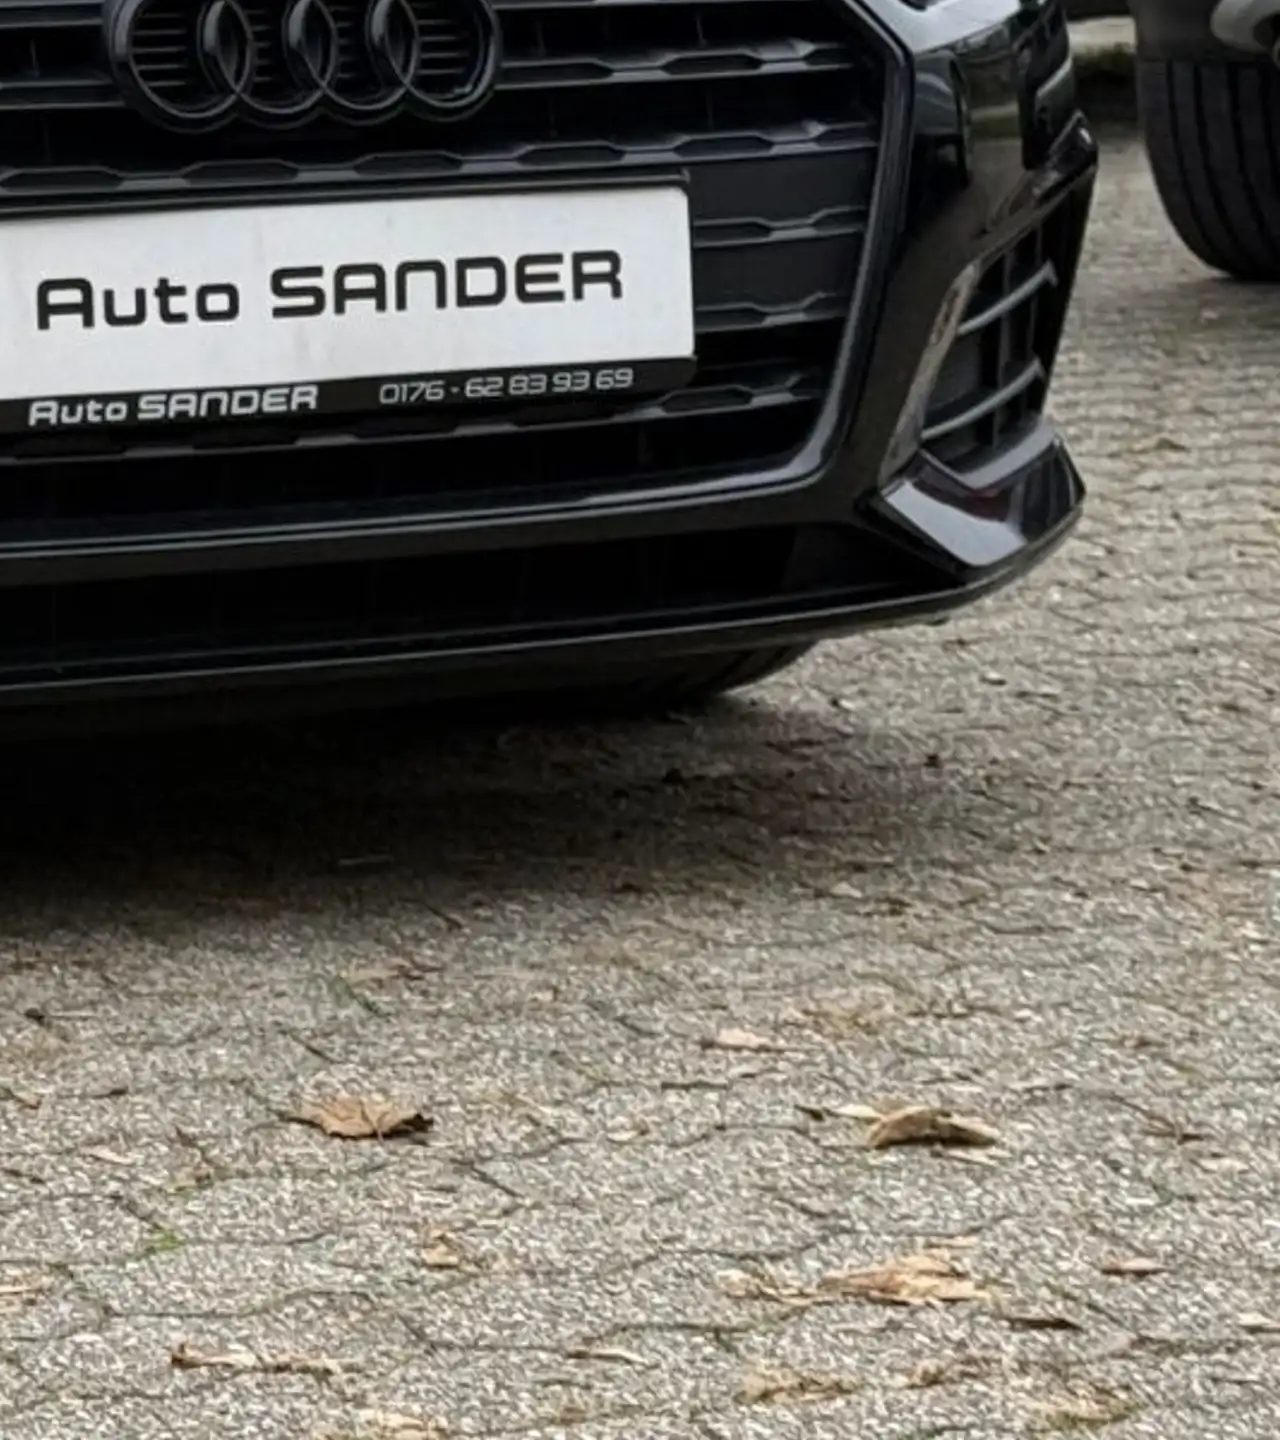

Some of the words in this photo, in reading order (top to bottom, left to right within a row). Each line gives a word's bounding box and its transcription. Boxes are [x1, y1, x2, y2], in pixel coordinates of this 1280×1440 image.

[36, 277, 240, 330] Auto
[269, 250, 623, 319] SANDER
[28, 399, 128, 426] Auto
[137, 384, 319, 421] SANDER
[379, 380, 444, 404] 0176
[464, 376, 504, 398] 62
[508, 373, 547, 396] 83
[551, 370, 590, 392] 93
[595, 368, 634, 391] 69
